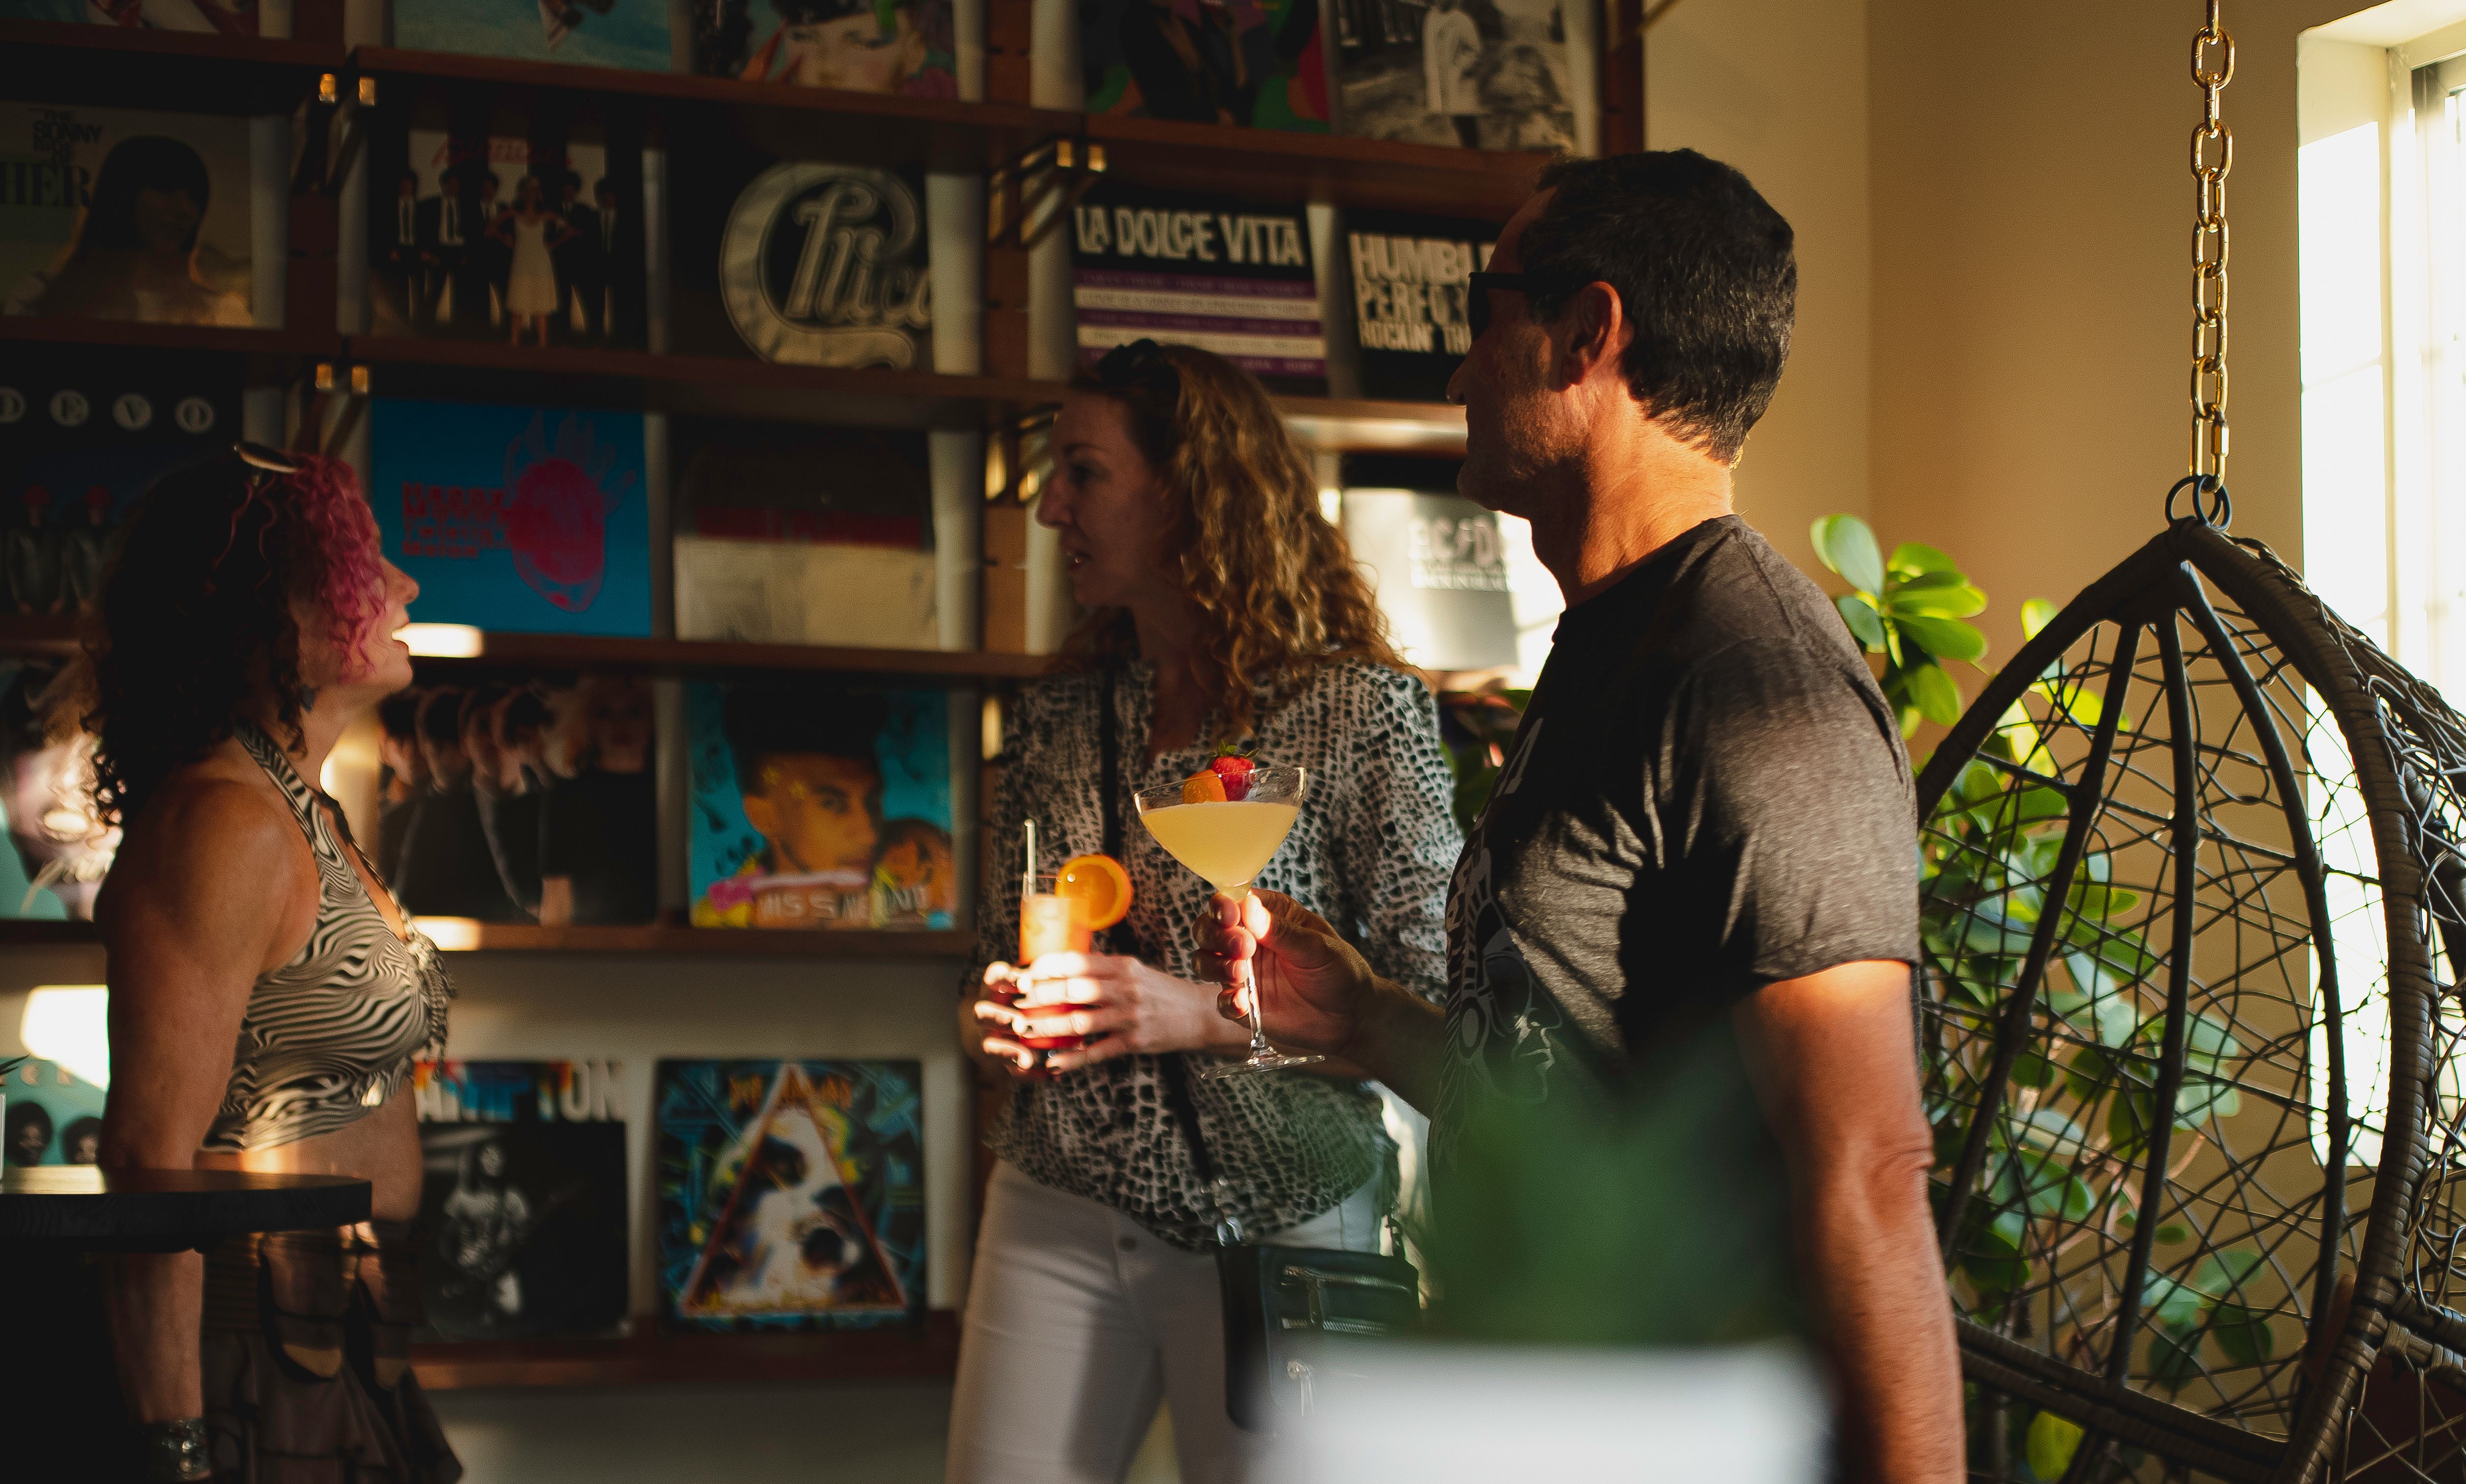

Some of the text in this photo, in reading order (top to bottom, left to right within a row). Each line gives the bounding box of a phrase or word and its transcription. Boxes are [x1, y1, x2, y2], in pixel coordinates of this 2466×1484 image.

[1073, 204, 1307, 268] LA DOLCE VITA
